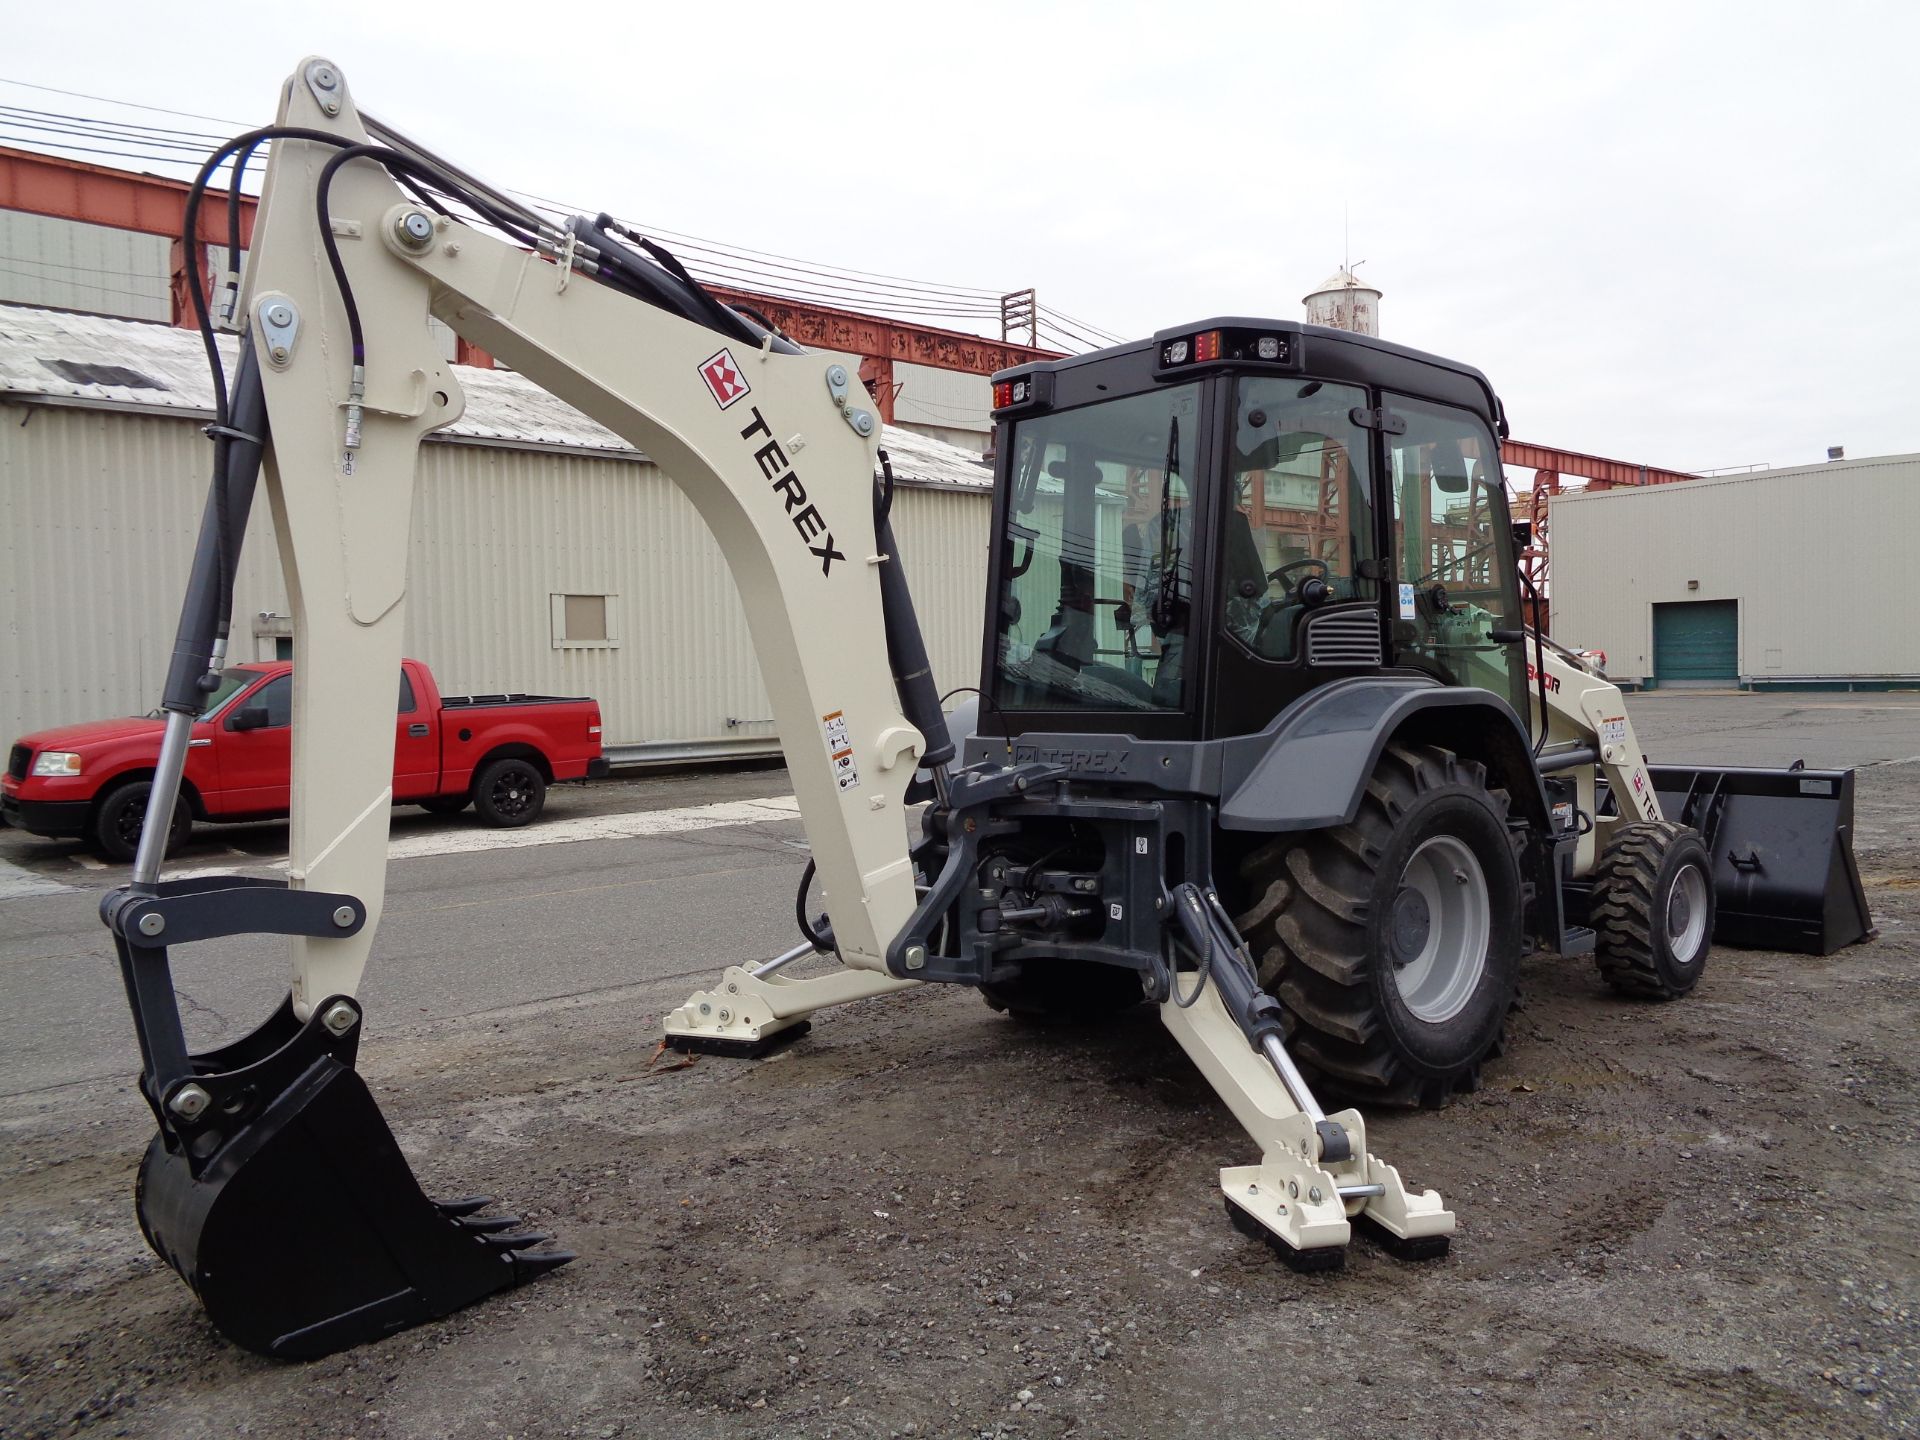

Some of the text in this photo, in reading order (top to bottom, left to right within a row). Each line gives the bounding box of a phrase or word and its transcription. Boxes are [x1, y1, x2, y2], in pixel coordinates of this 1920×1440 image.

[740, 405, 847, 579] TEREX
[1042, 748, 1129, 775] TEREX
[1643, 790, 1659, 821] TE
